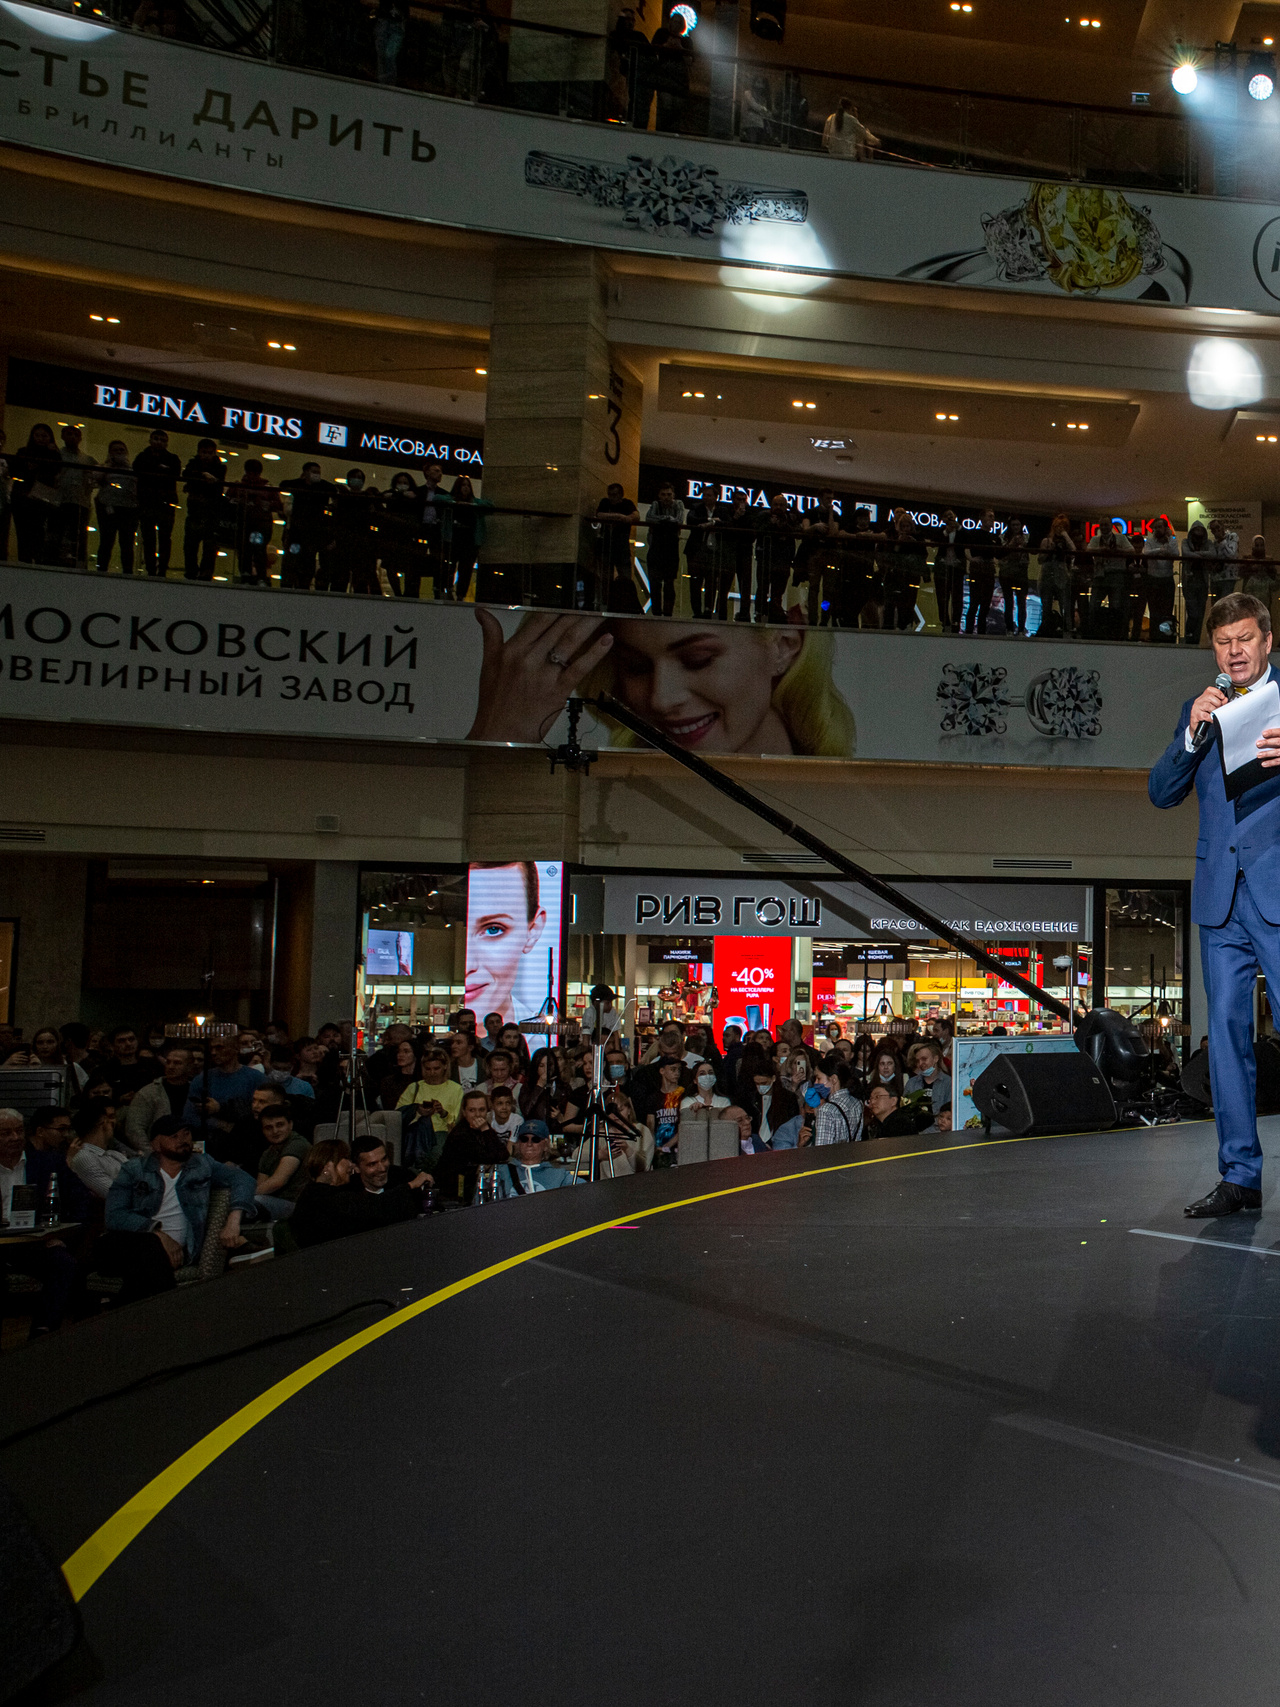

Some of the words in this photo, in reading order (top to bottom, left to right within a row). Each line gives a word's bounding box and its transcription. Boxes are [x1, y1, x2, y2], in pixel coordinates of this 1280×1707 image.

[17, 99, 285, 170] БРИЛЛИАНТЫ
[192, 88, 438, 164] ДАРИТЬ
[93, 383, 209, 425] ELENA
[221, 406, 304, 440] FURS
[360, 432, 450, 462] МЕХОВАЯ
[686, 479, 771, 509] EENA
[0, 655, 262, 698] ВЕЛИРНЫЙ
[279, 675, 415, 714] ЗАВОД
[636, 894, 722, 926] РИВ
[733, 896, 822, 927] ГОШ
[870, 918, 931, 931] КРАСОТ
[974, 920, 1079, 933] ВДОХНОВЕНИЕ
